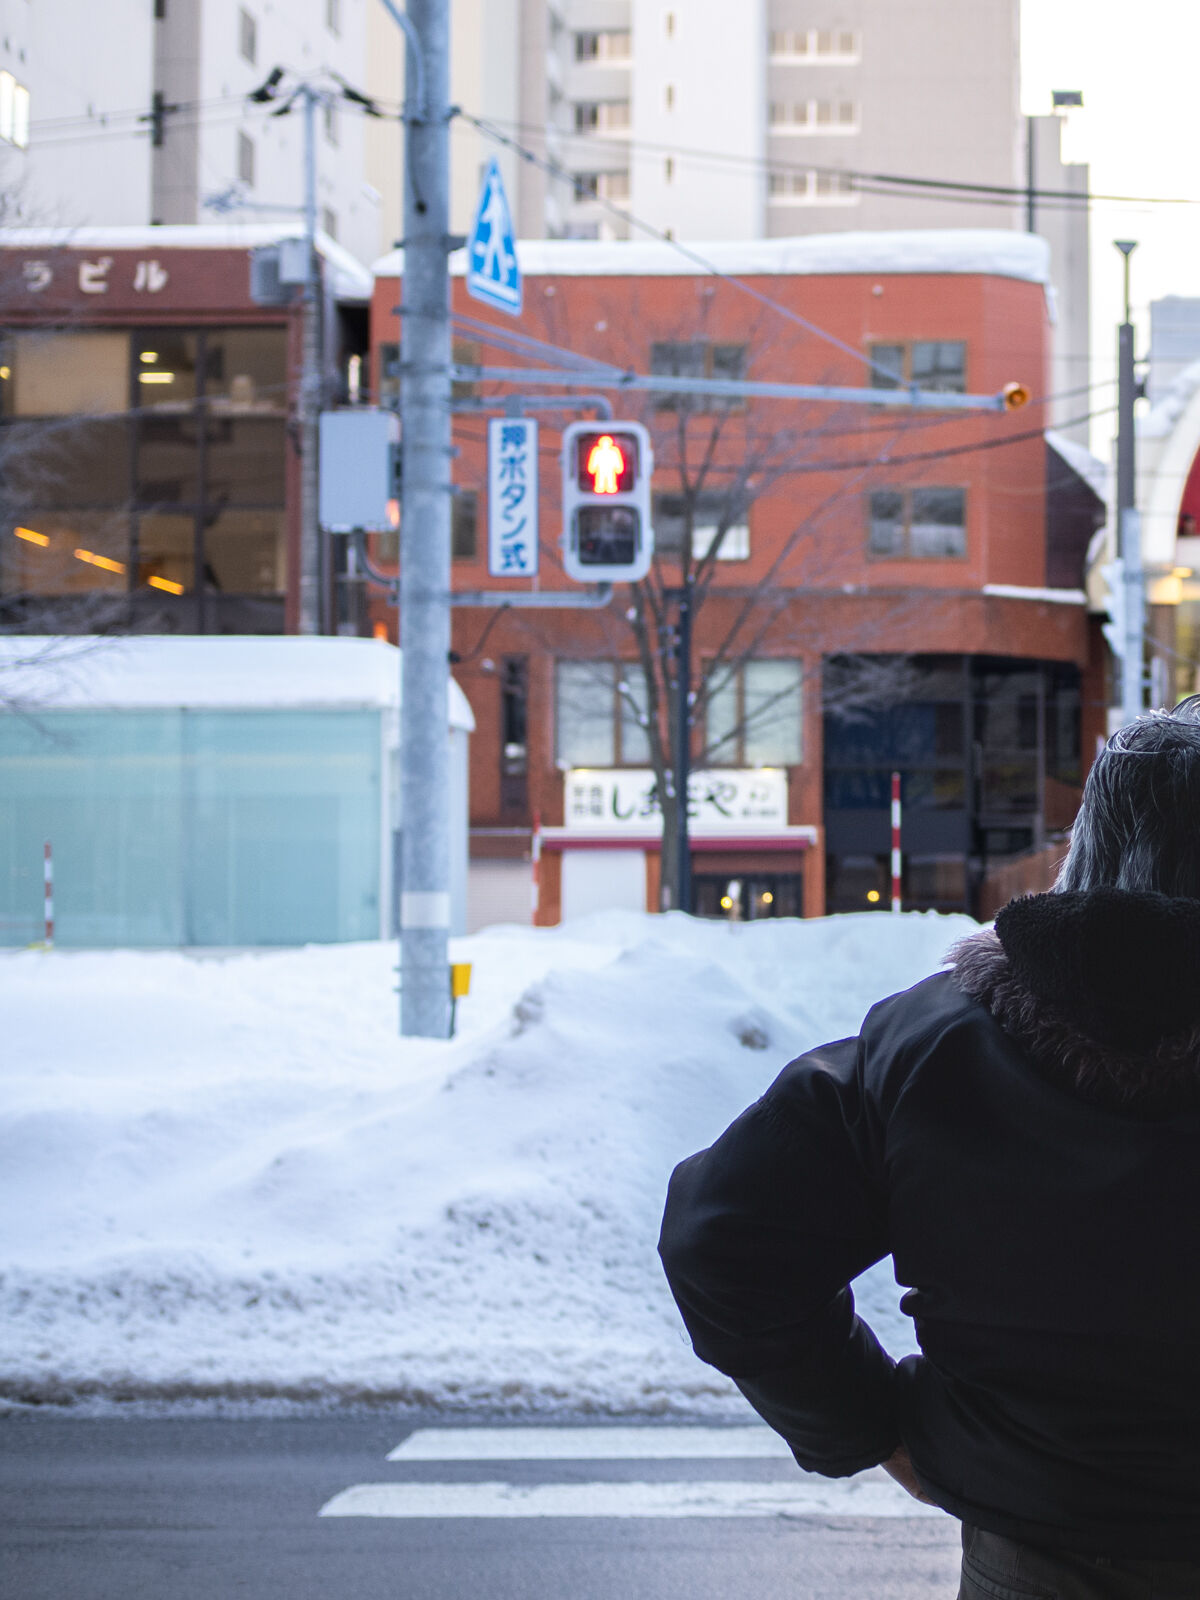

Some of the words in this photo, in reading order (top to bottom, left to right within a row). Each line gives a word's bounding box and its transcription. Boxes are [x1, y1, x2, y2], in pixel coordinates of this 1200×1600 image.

[22, 256, 168, 293] ラビル
[500, 426, 526, 570] 押ボタン式
